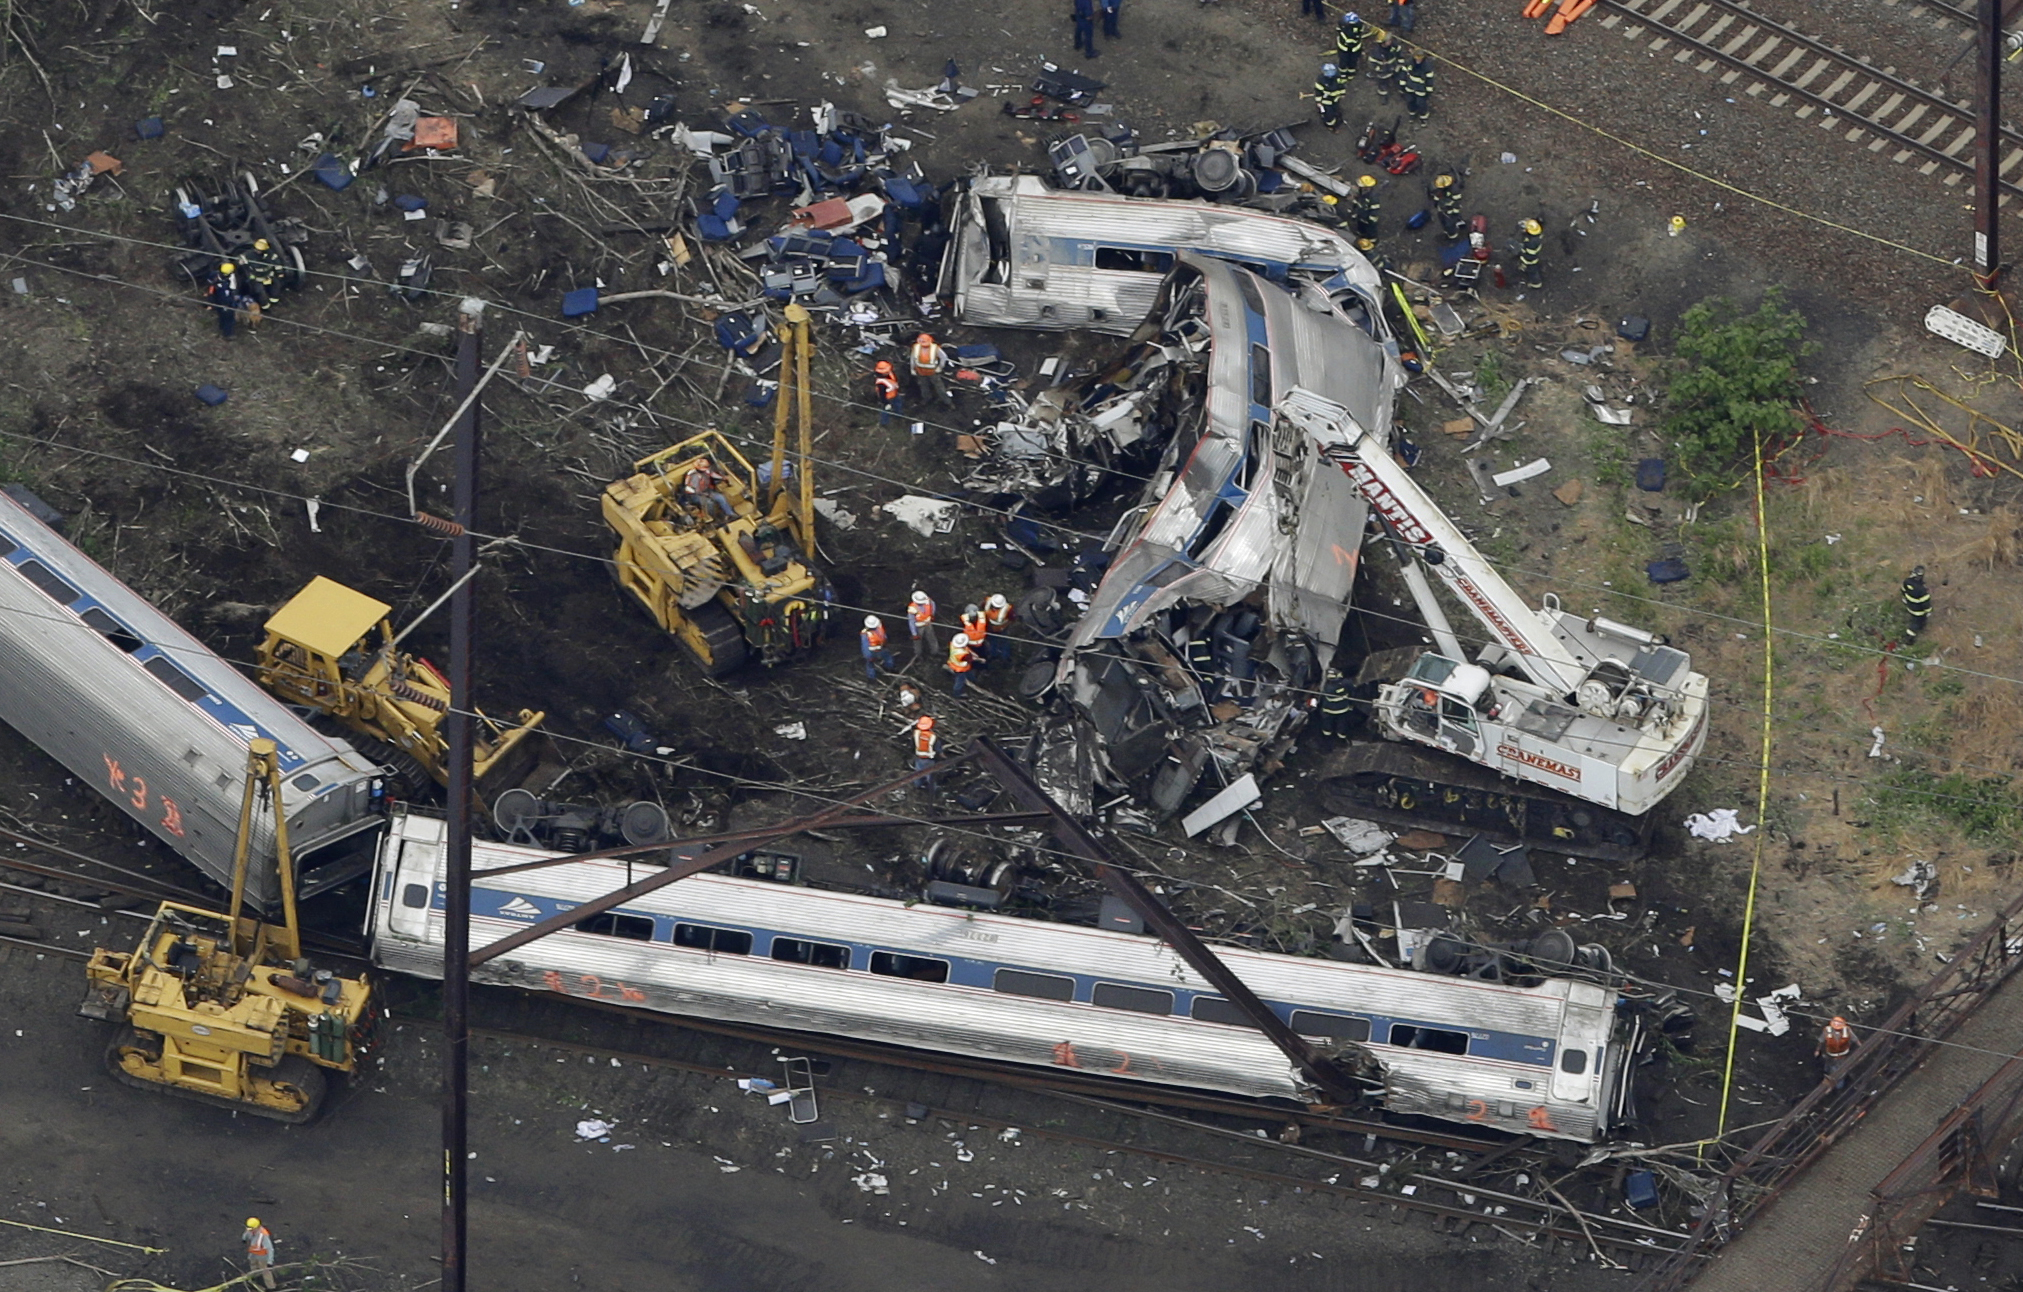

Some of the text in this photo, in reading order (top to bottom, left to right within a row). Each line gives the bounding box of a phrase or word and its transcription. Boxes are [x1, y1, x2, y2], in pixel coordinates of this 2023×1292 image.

[1347, 463, 1426, 543] MANTIS
[1456, 577, 1534, 655] CRANEMASTERS
[500, 911, 536, 919] AMTRAK
